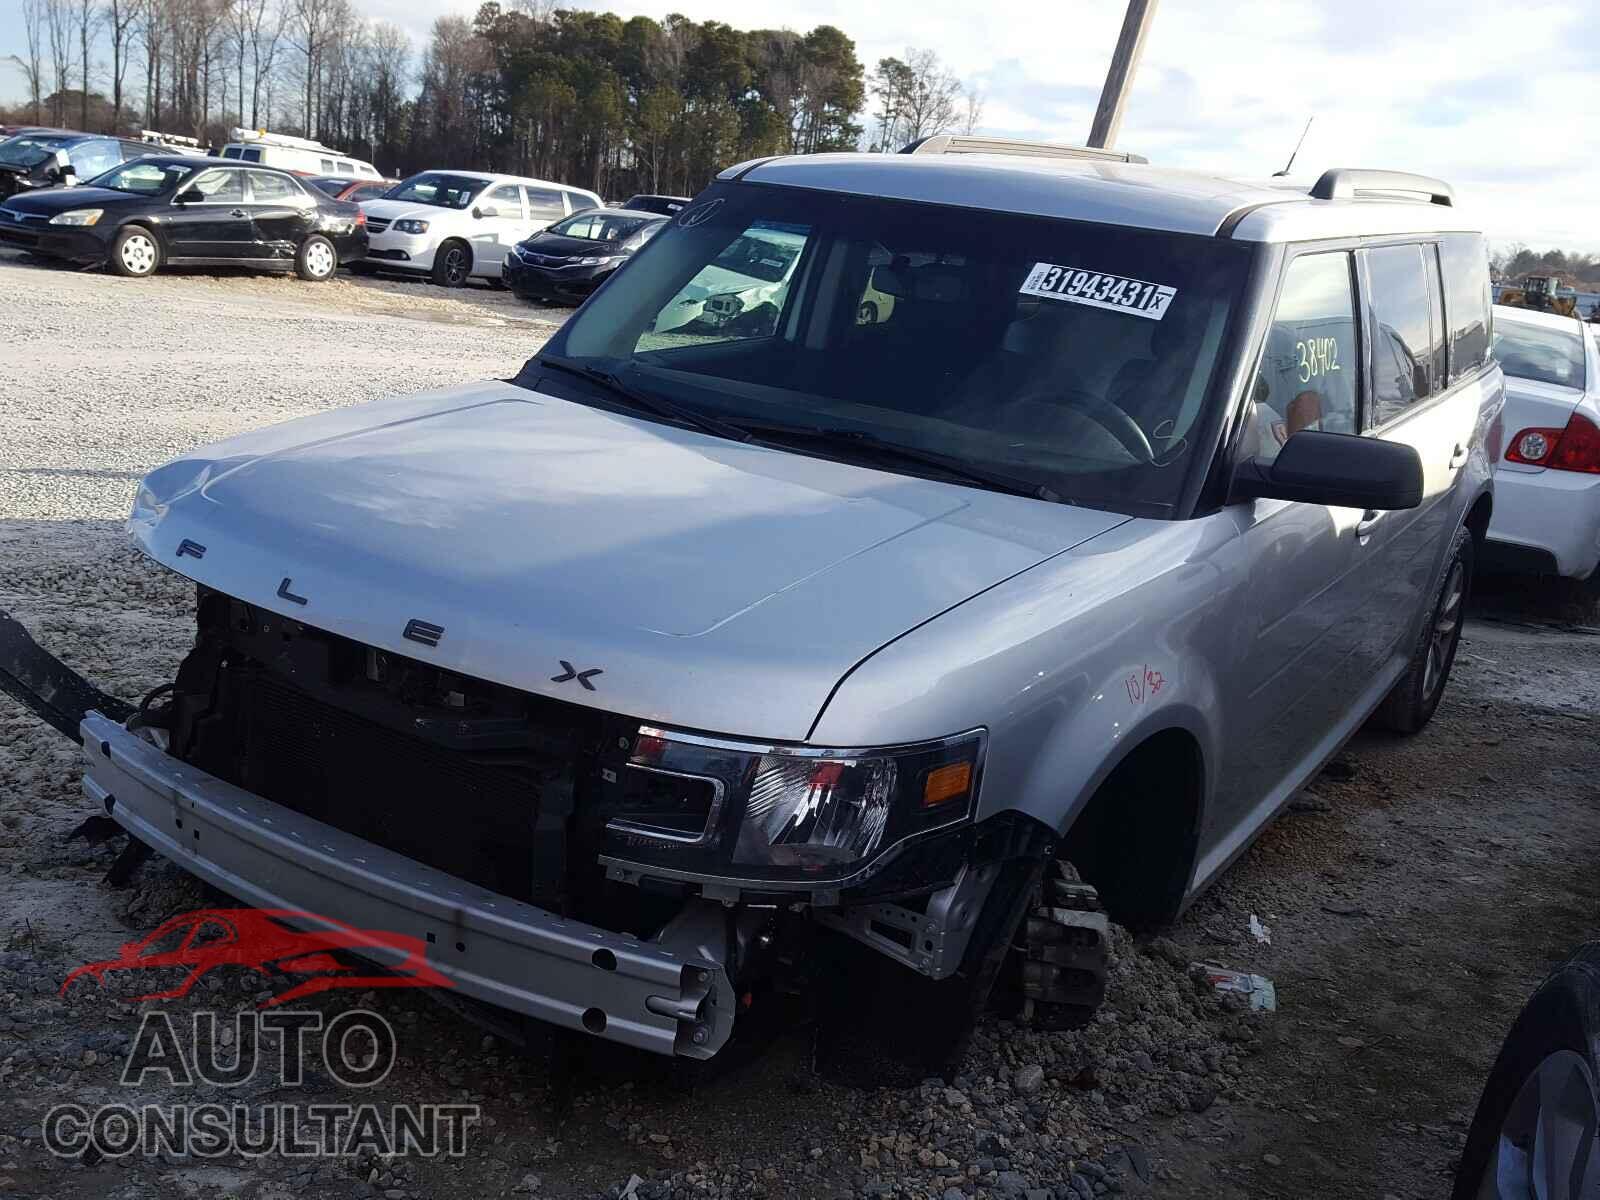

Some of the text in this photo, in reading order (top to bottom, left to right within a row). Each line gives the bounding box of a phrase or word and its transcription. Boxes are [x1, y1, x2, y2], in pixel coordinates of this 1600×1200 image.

[1040, 266, 1156, 311] 31943431
[1150, 295, 1165, 310] X
[1296, 337, 1341, 383] 38402
[175, 538, 604, 692] FLEX
